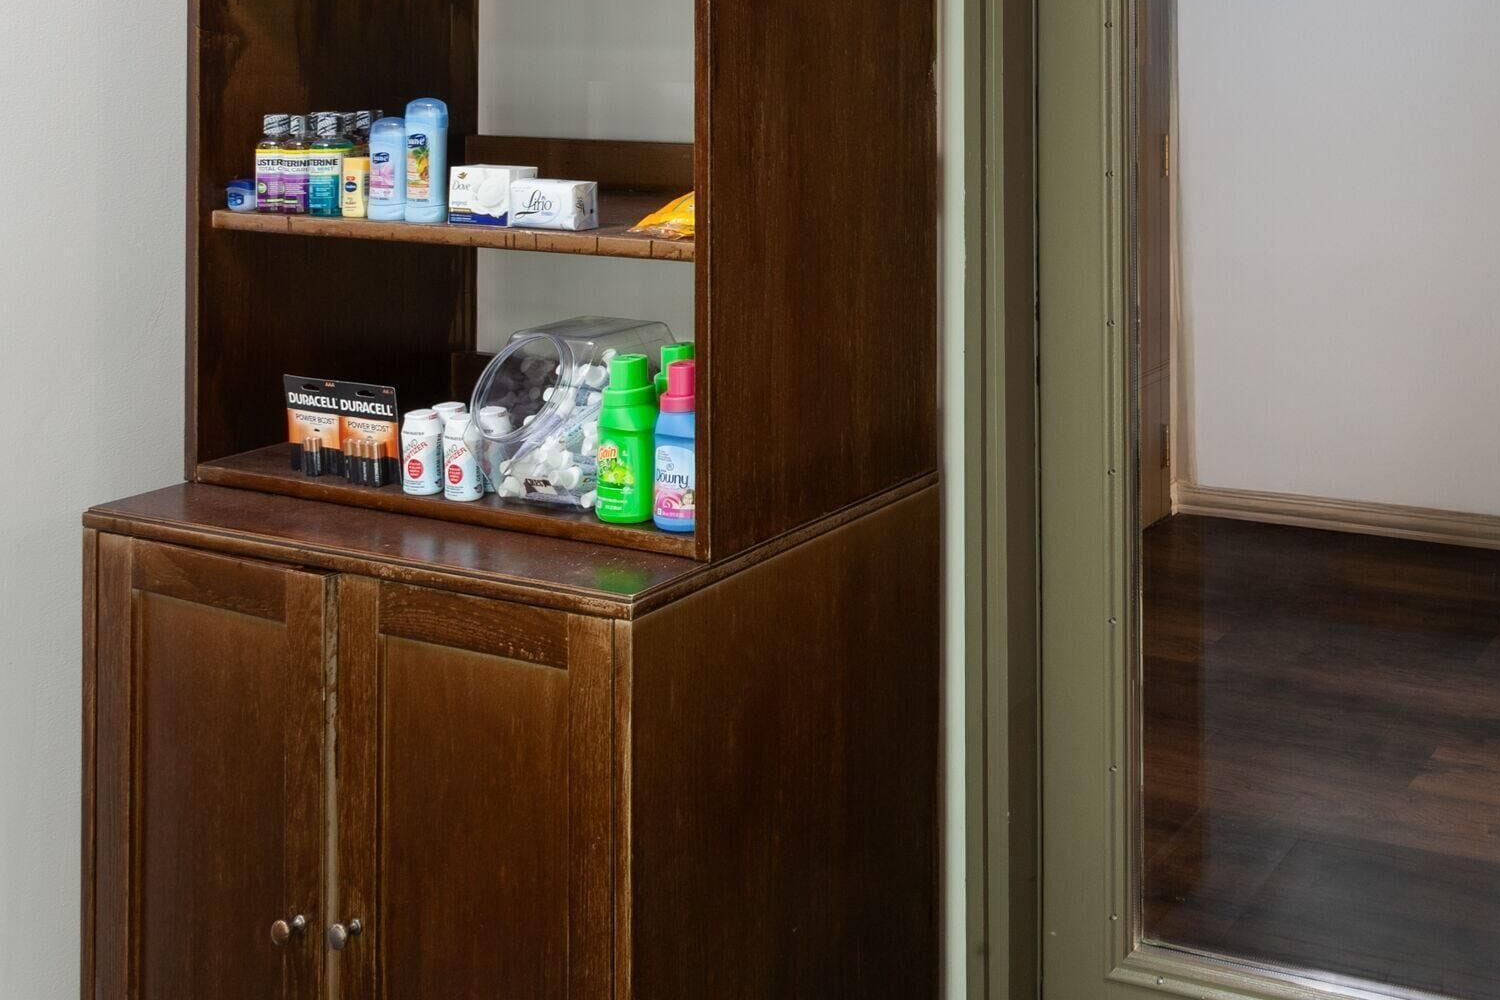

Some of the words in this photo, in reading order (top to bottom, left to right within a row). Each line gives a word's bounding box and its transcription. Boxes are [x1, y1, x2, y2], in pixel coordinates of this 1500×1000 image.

[452, 181, 470, 191] Dove
[288, 391, 339, 410] DURACELL
[340, 399, 394, 417] DURACELL
[295, 413, 316, 422] POWER
[317, 416, 337, 425] BOOST
[347, 421, 370, 431] POWER
[371, 424, 390, 433] BOOST
[655, 469, 690, 489] Downy
